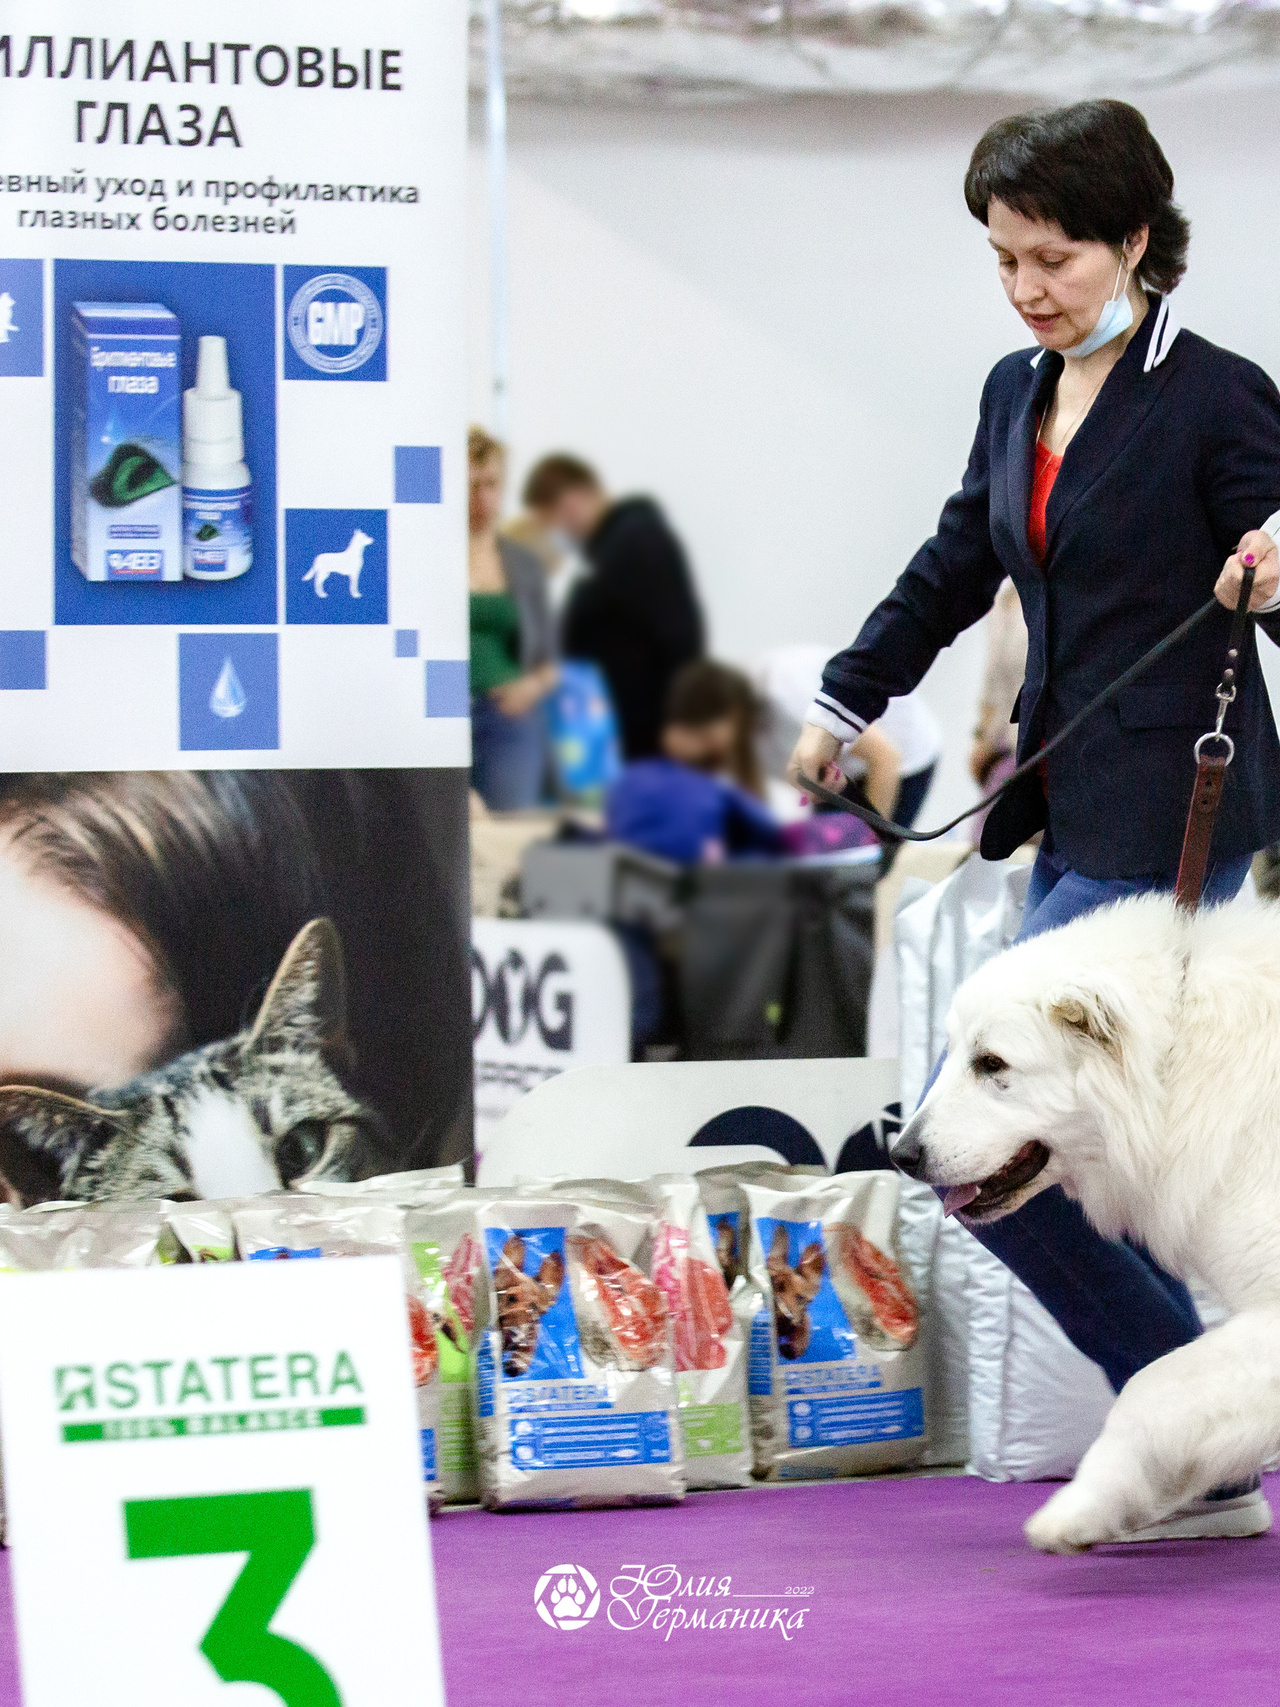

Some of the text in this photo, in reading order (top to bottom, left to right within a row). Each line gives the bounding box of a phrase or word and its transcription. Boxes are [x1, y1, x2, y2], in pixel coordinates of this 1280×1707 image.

[74, 100, 244, 147] ГЛАЗА
[94, 177, 167, 202] уход
[177, 179, 193, 197] и
[204, 175, 419, 205] профилактика
[18, 206, 297, 234] глазных болезней
[308, 301, 365, 345] GMP
[104, 1350, 365, 1411] STATERA
